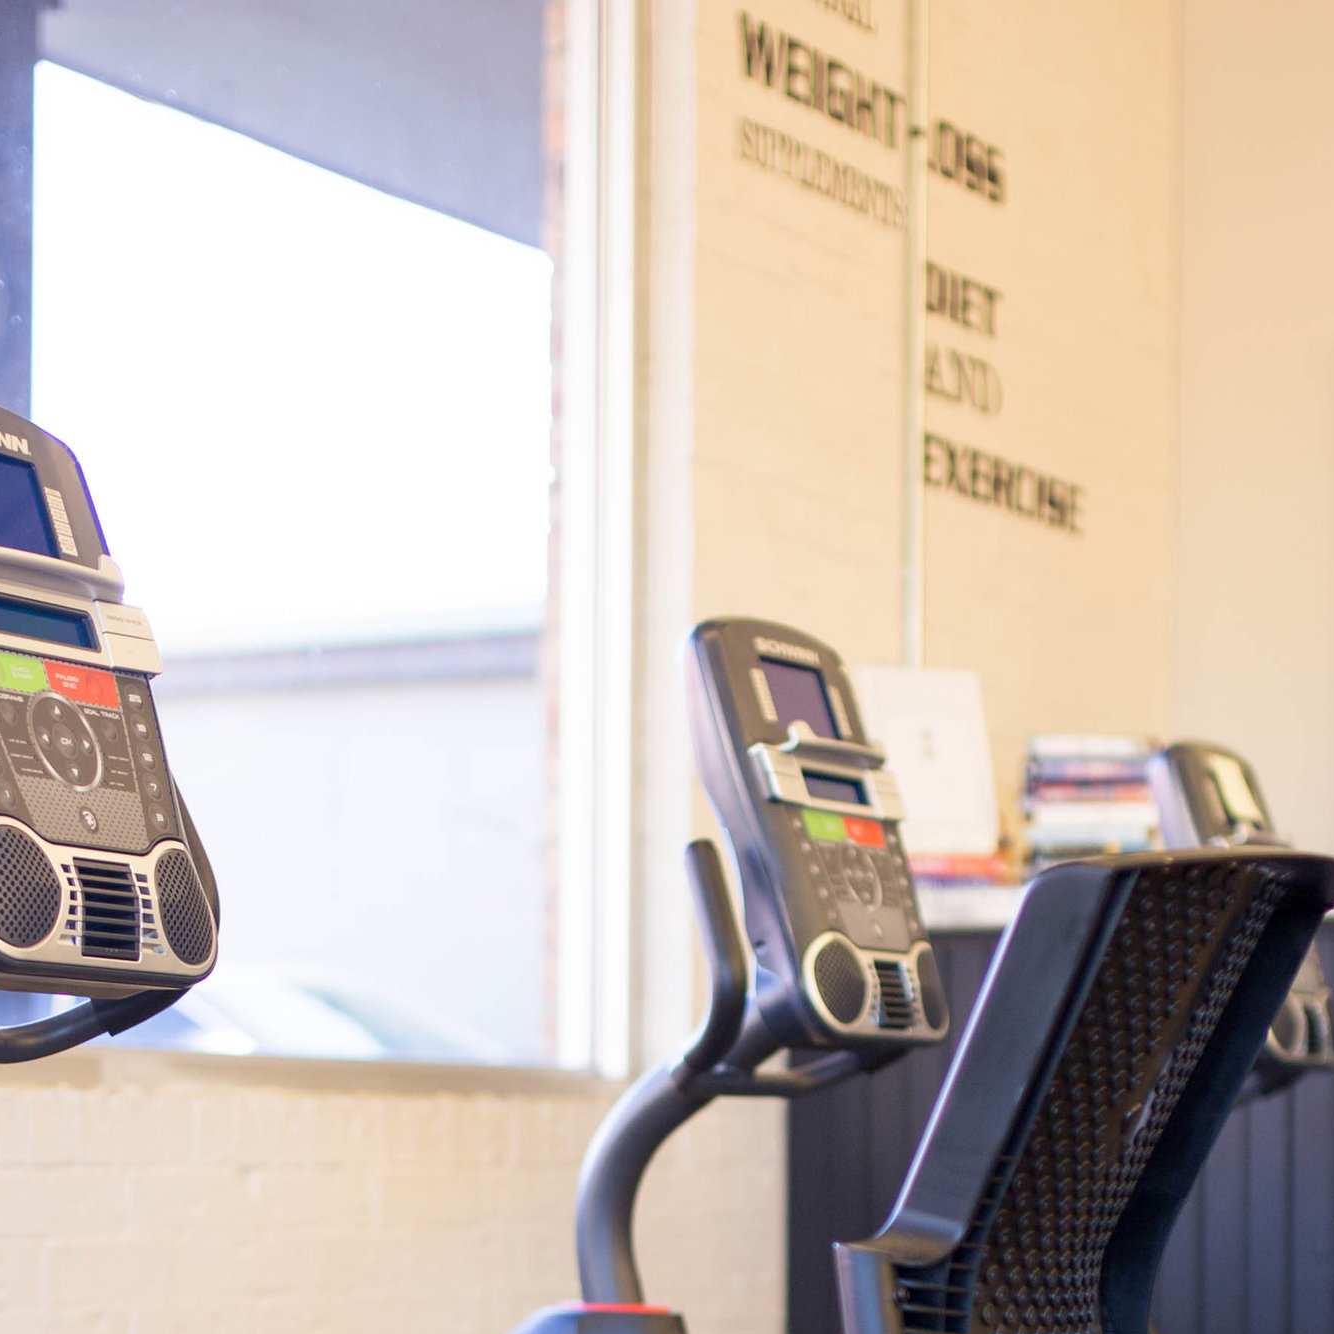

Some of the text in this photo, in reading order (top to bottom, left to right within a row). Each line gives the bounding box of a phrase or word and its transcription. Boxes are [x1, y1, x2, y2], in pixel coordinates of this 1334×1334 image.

[737, 10, 907, 149] WEIGHT
[925, 260, 1004, 338] DIET
[924, 431, 1087, 537] EXERCISE
[60, 737, 74, 747] OK
